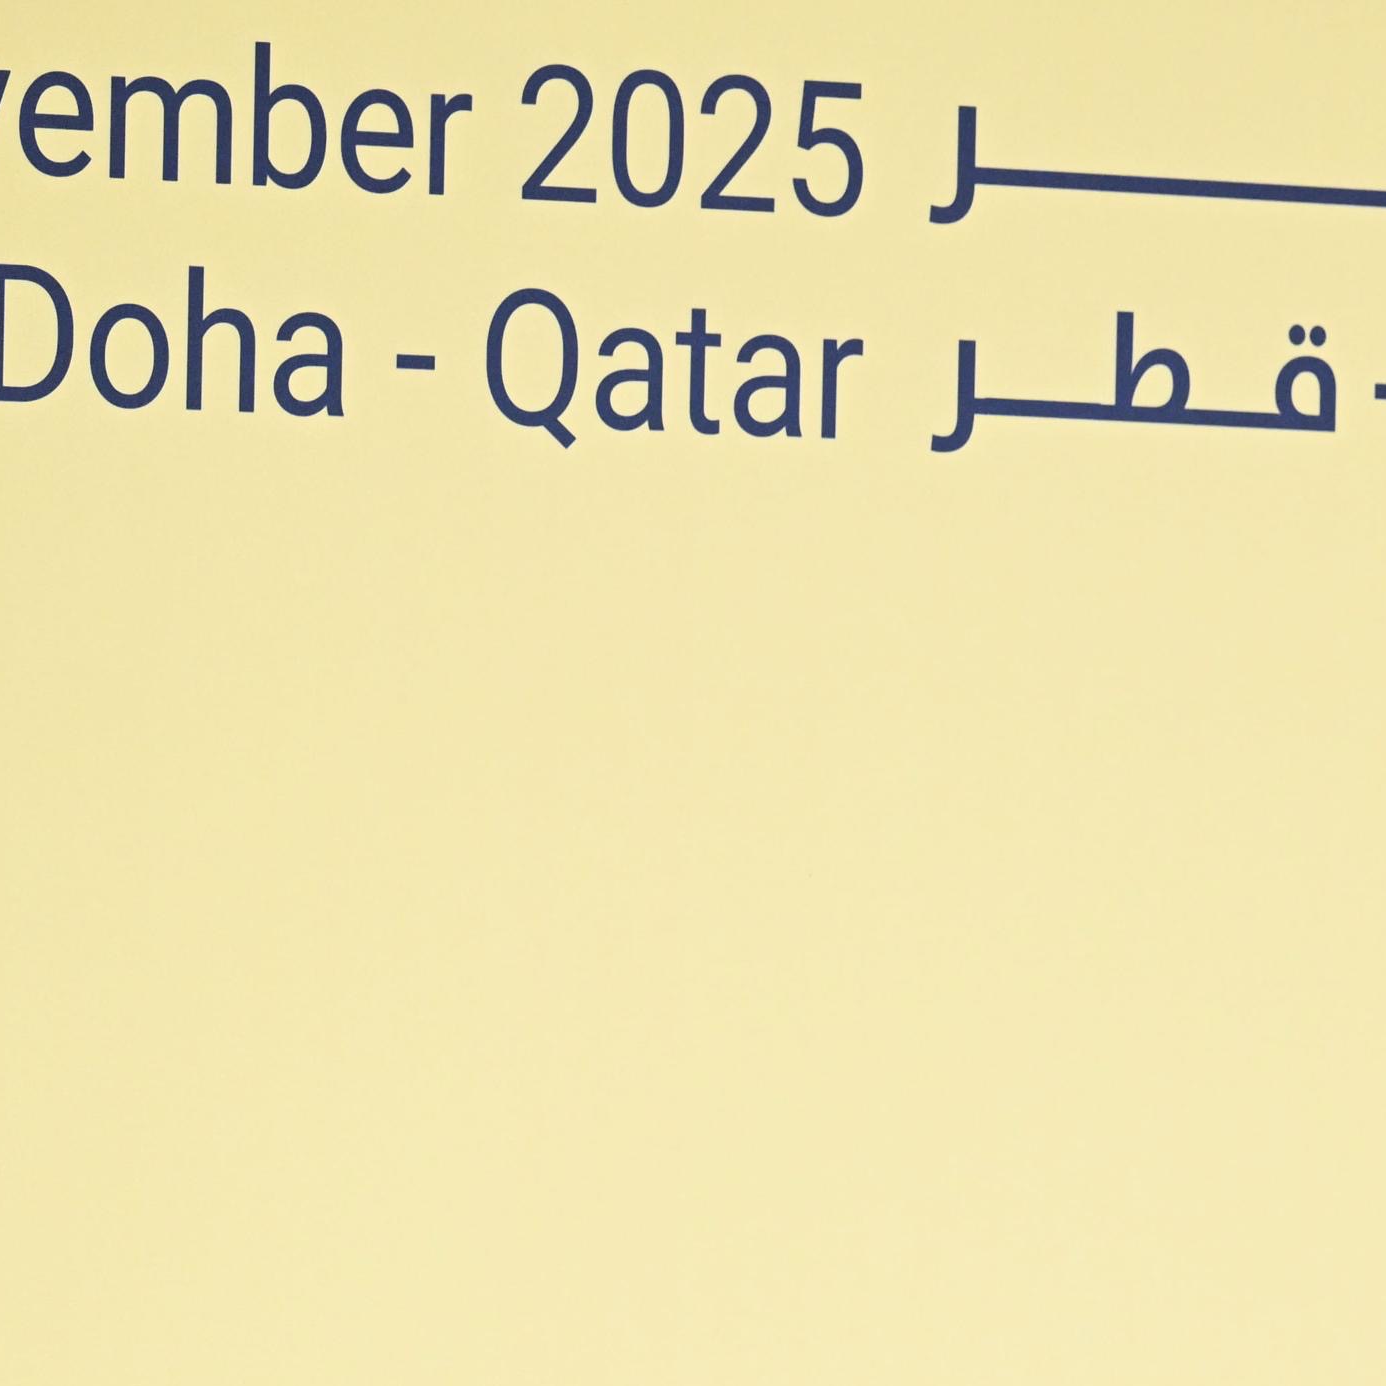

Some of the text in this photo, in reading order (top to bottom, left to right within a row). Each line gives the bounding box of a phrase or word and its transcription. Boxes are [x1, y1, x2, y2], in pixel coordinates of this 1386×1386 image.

[521, 63, 864, 218] 2025
[486, 287, 864, 449] Qatar
[930, 310, 1337, 453] قطر
